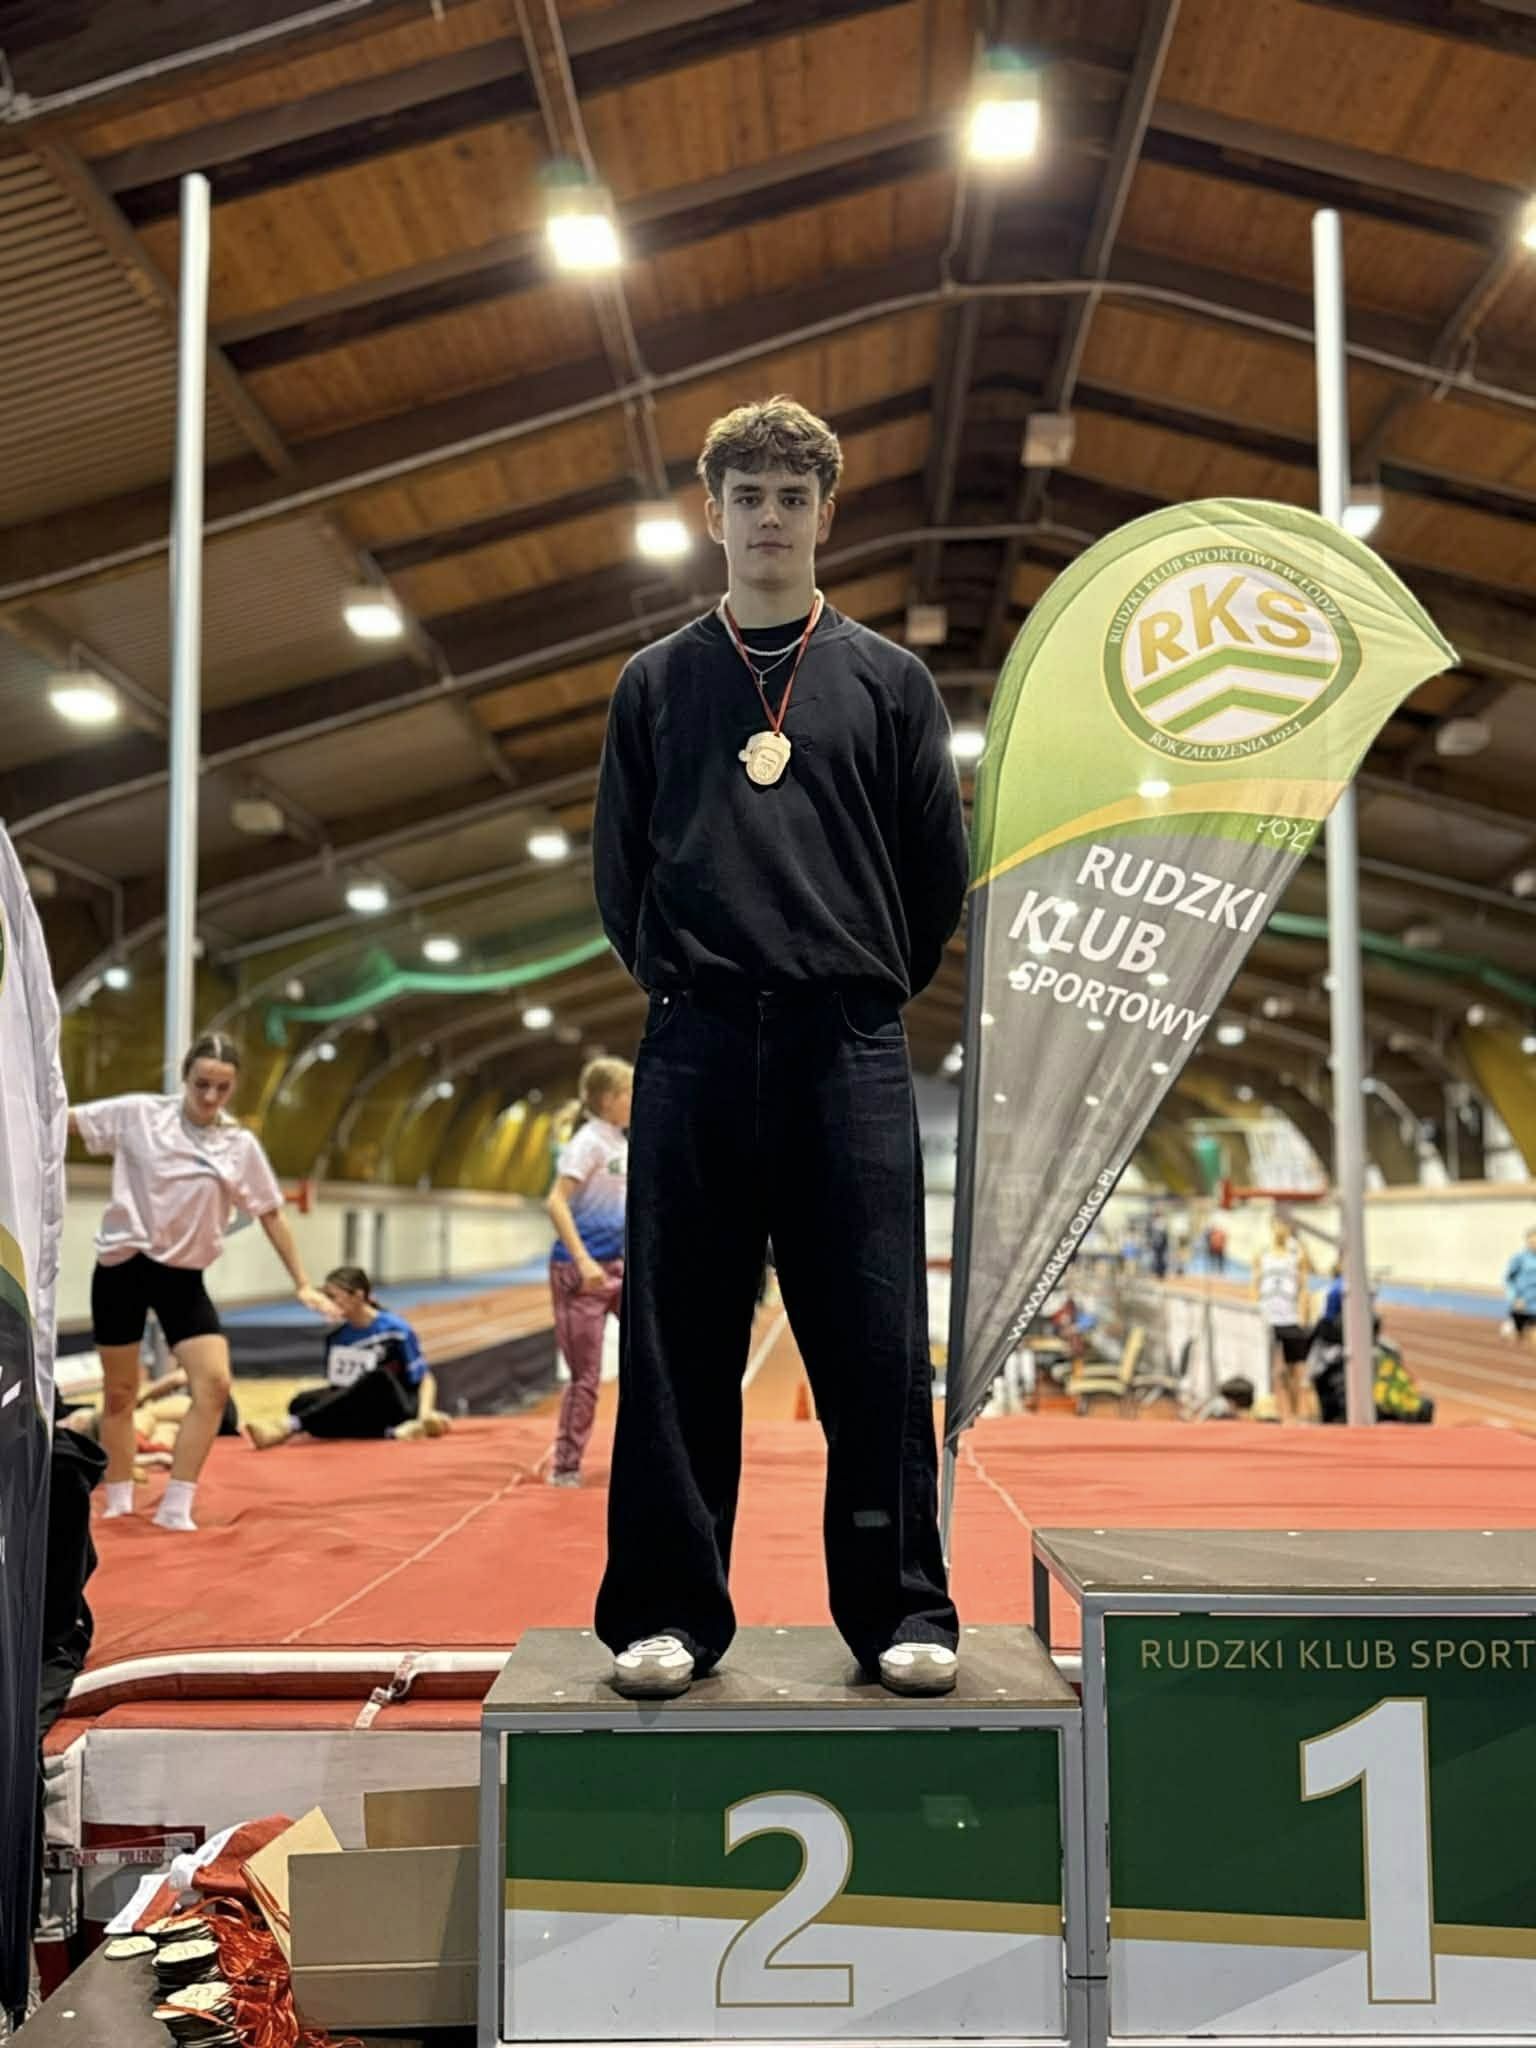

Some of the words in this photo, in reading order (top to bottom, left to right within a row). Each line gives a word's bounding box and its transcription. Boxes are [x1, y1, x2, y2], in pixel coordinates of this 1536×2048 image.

[1108, 587, 1145, 643] RUDZKI
[1143, 558, 1183, 590] KLUB
[1184, 548, 1283, 570] SPORTOWY
[1282, 566, 1299, 580] W
[1138, 575, 1312, 677] RKS
[1150, 732, 1176, 753] ROK
[1008, 890, 1166, 973] KLUB
[1076, 844, 1268, 933] RUDZKI
[1010, 961, 1209, 1041] SPORTOWY
[1008, 1166, 1120, 1341] WWW.RKS.ORG.PL
[1141, 1639, 1283, 1669] RUDZKI
[1300, 1639, 1397, 1669] KLUB
[1410, 1639, 1536, 1669] SPORT
[1300, 1696, 1437, 2005] 1
[716, 1789, 854, 2007] 2
